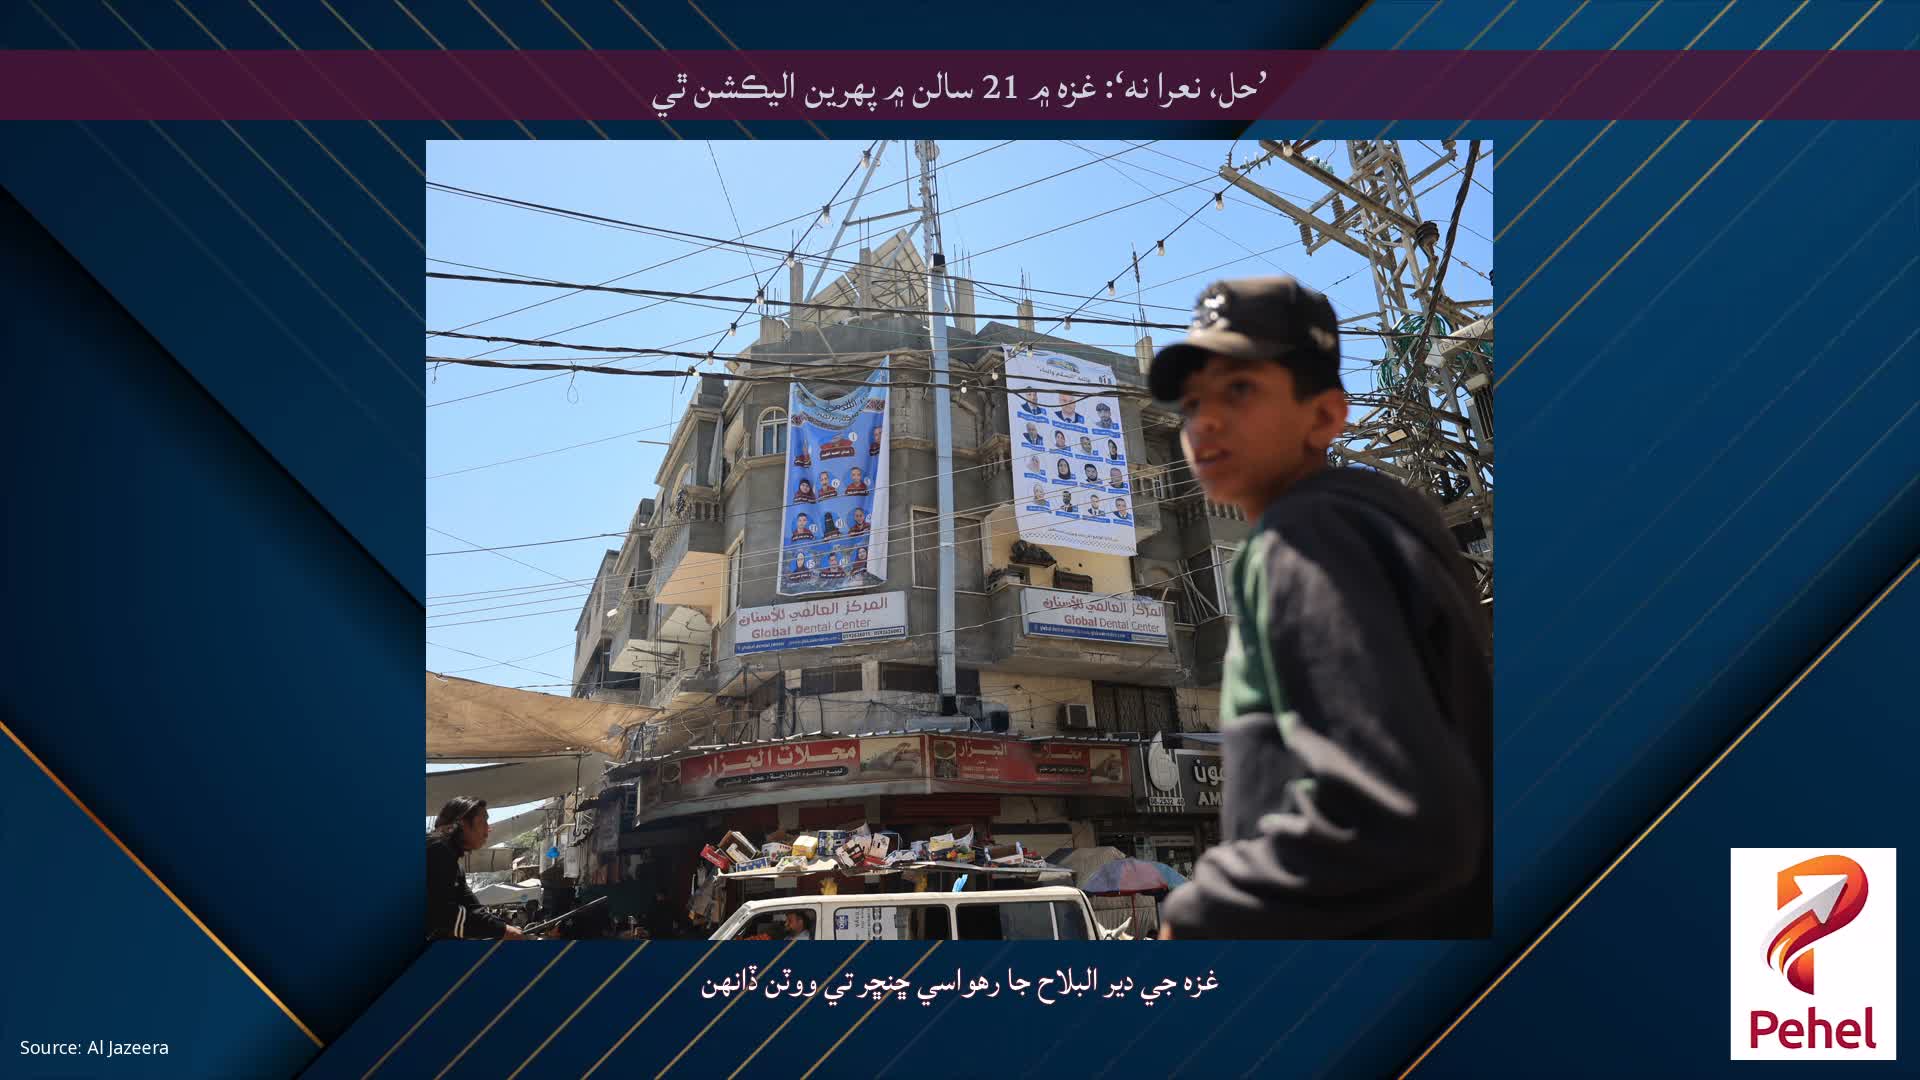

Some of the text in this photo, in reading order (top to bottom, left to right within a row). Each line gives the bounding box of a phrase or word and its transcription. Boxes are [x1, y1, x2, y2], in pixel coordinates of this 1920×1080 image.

[738, 596, 888, 627] المركز العالمي للأسنان
[1043, 594, 1166, 617] المركز العالمي للأسنان
[751, 617, 872, 639] Global Dental Center
[1064, 614, 1098, 628] Global
[1099, 617, 1129, 631] Dental
[1131, 620, 1160, 634] Center
[704, 744, 856, 778] محلات الجزار
[959, 740, 1008, 760] الجزار
